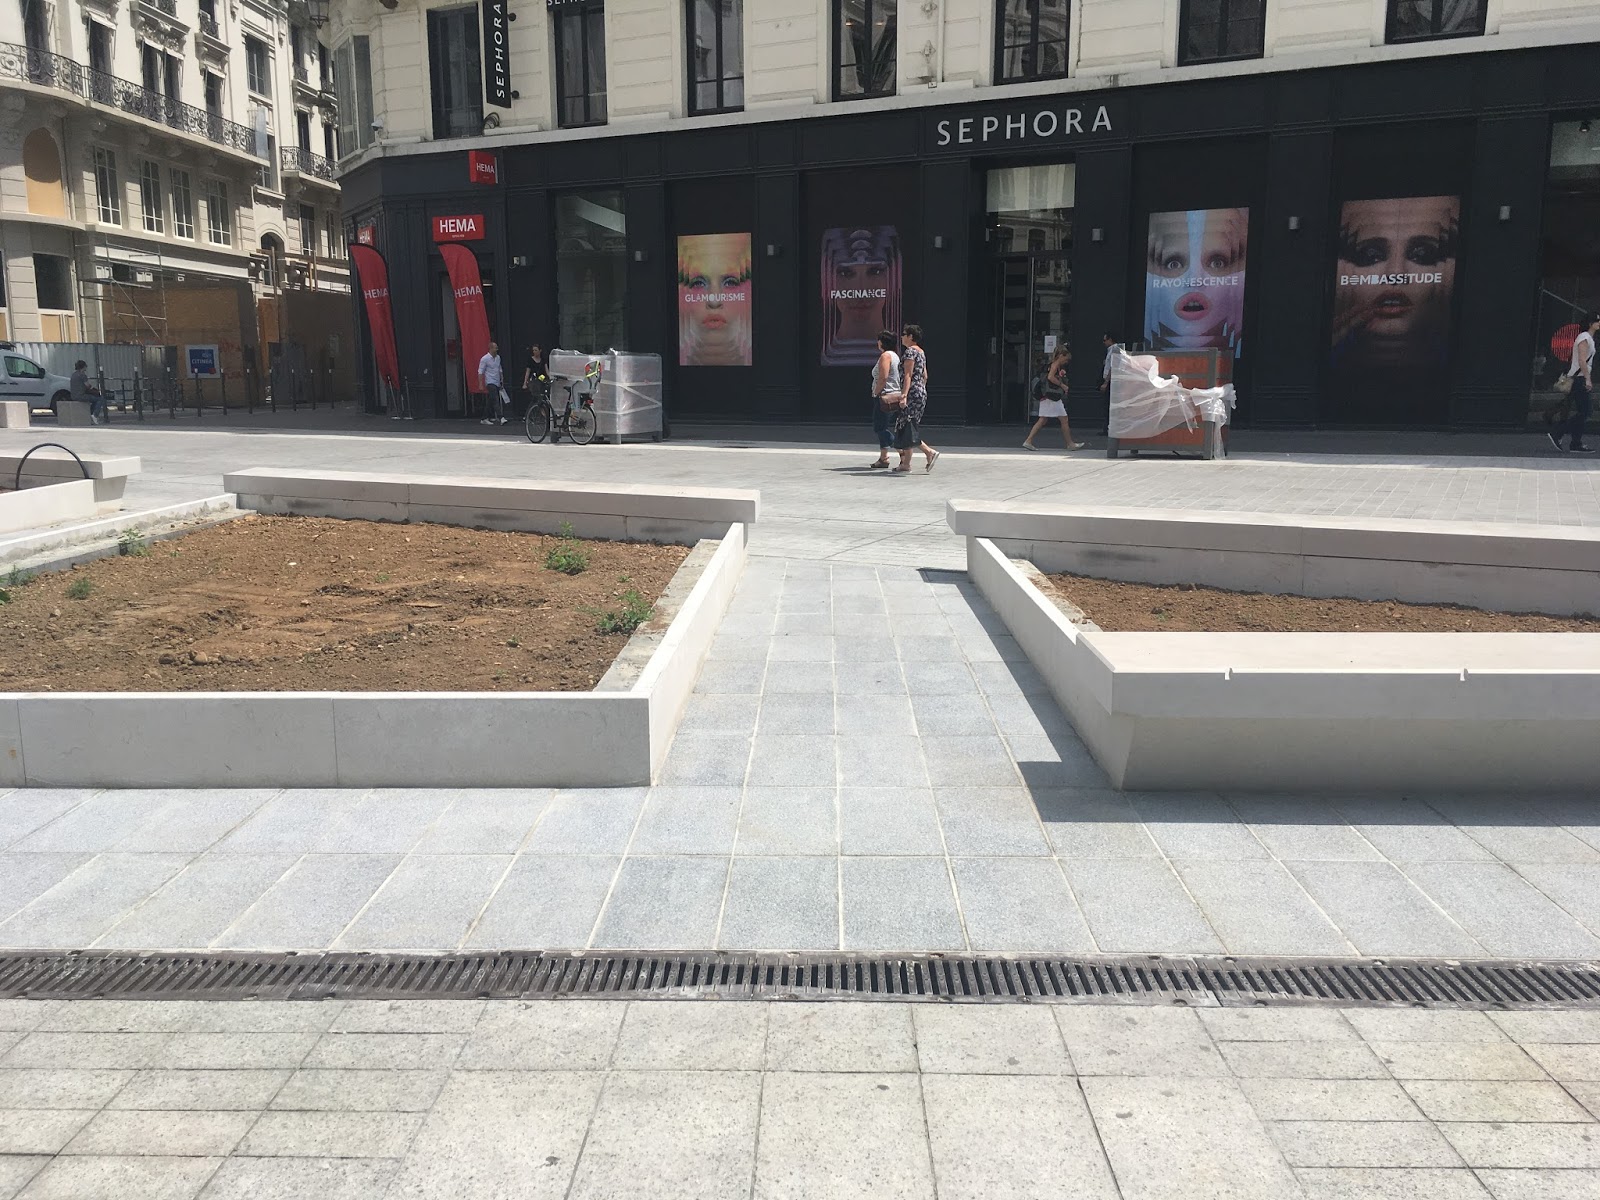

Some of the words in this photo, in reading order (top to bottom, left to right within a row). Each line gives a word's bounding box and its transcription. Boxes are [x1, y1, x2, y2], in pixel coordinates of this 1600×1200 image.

[493, 3, 505, 98] SEPHORA
[937, 105, 1112, 146] SEPHORA
[476, 162, 495, 174] HEMA
[440, 218, 476, 233] HEMA
[1152, 276, 1239, 288] RAYONESCENCE
[1340, 272, 1442, 286] BOMBASSITUDE
[363, 288, 389, 299] HEMA
[454, 285, 482, 299] HEMA
[685, 292, 745, 303] GLAMOURISME
[830, 289, 886, 299] FASCINANCE
